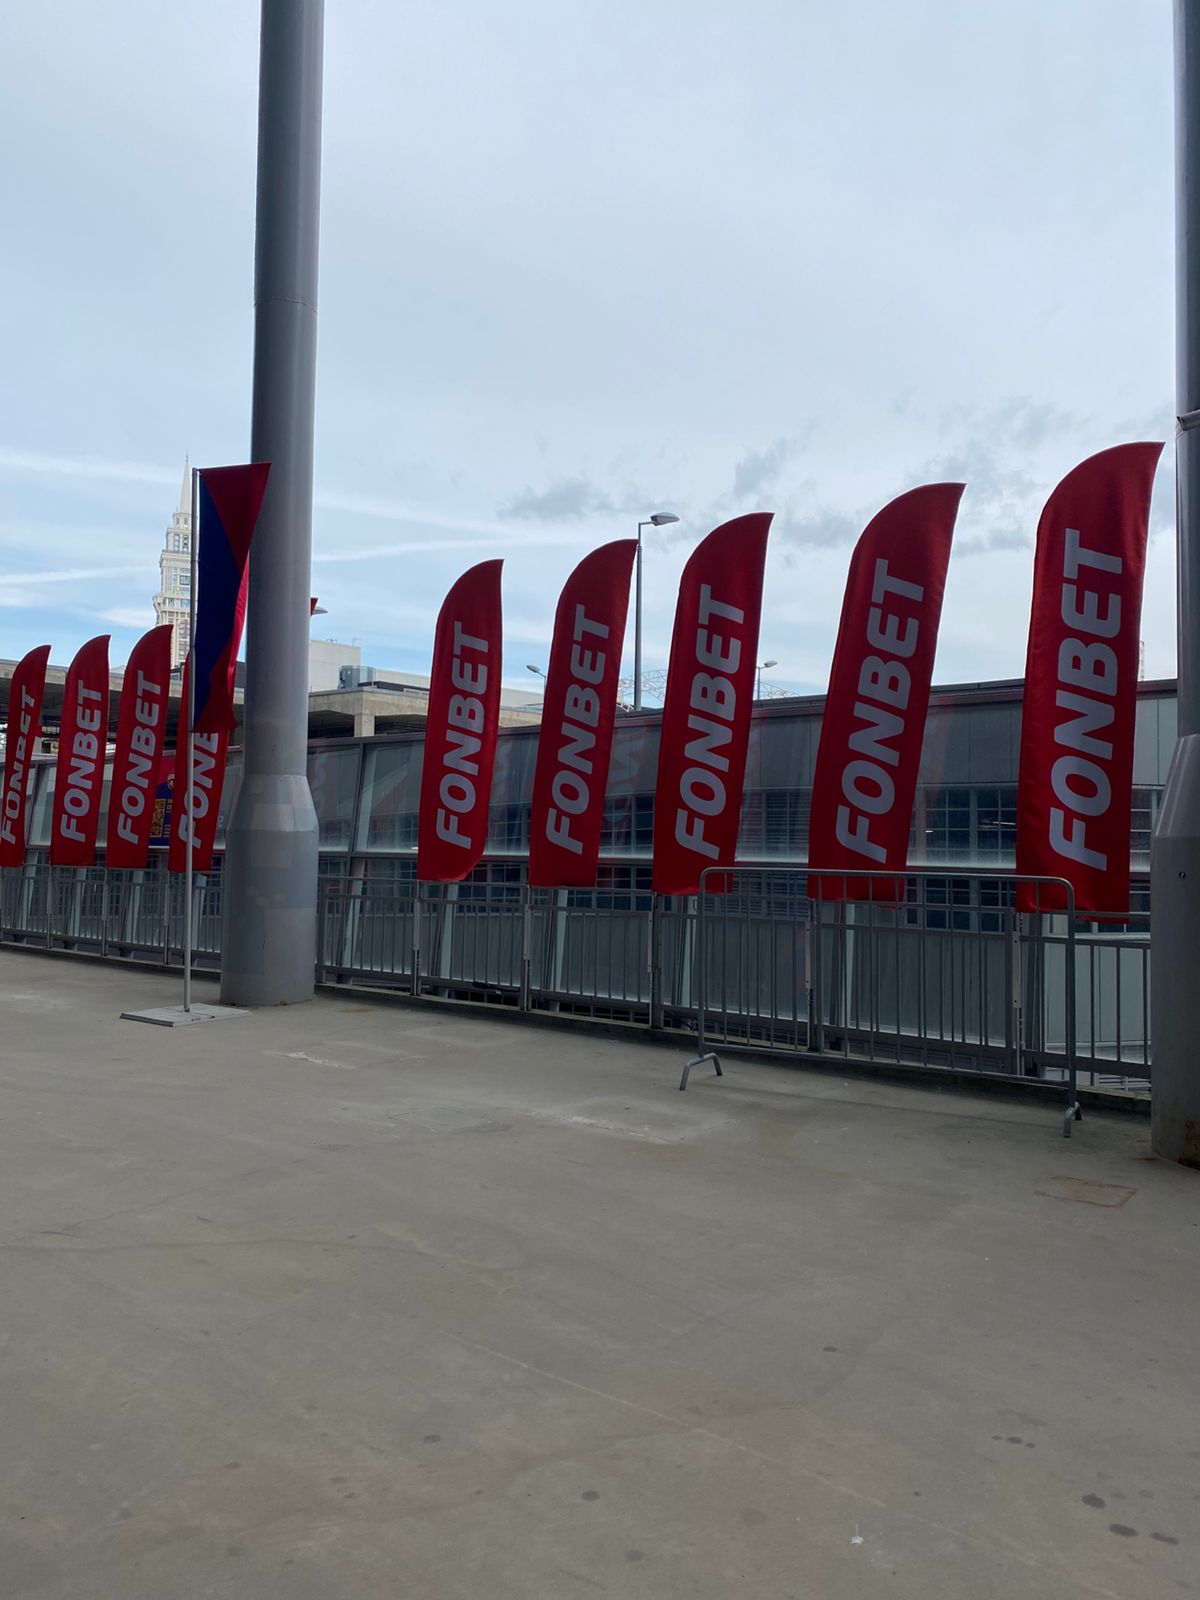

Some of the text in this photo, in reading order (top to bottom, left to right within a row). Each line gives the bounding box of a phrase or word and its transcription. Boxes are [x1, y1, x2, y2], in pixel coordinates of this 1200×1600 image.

[1, 685, 35, 845] FONBET
[60, 680, 103, 843] FONBET
[116, 669, 162, 845] FONBET
[435, 620, 489, 850] FONBET
[545, 603, 610, 855] FONBET
[674, 583, 745, 861] FONBET
[835, 557, 924, 865] FONBET
[1048, 527, 1123, 872] FONBET
